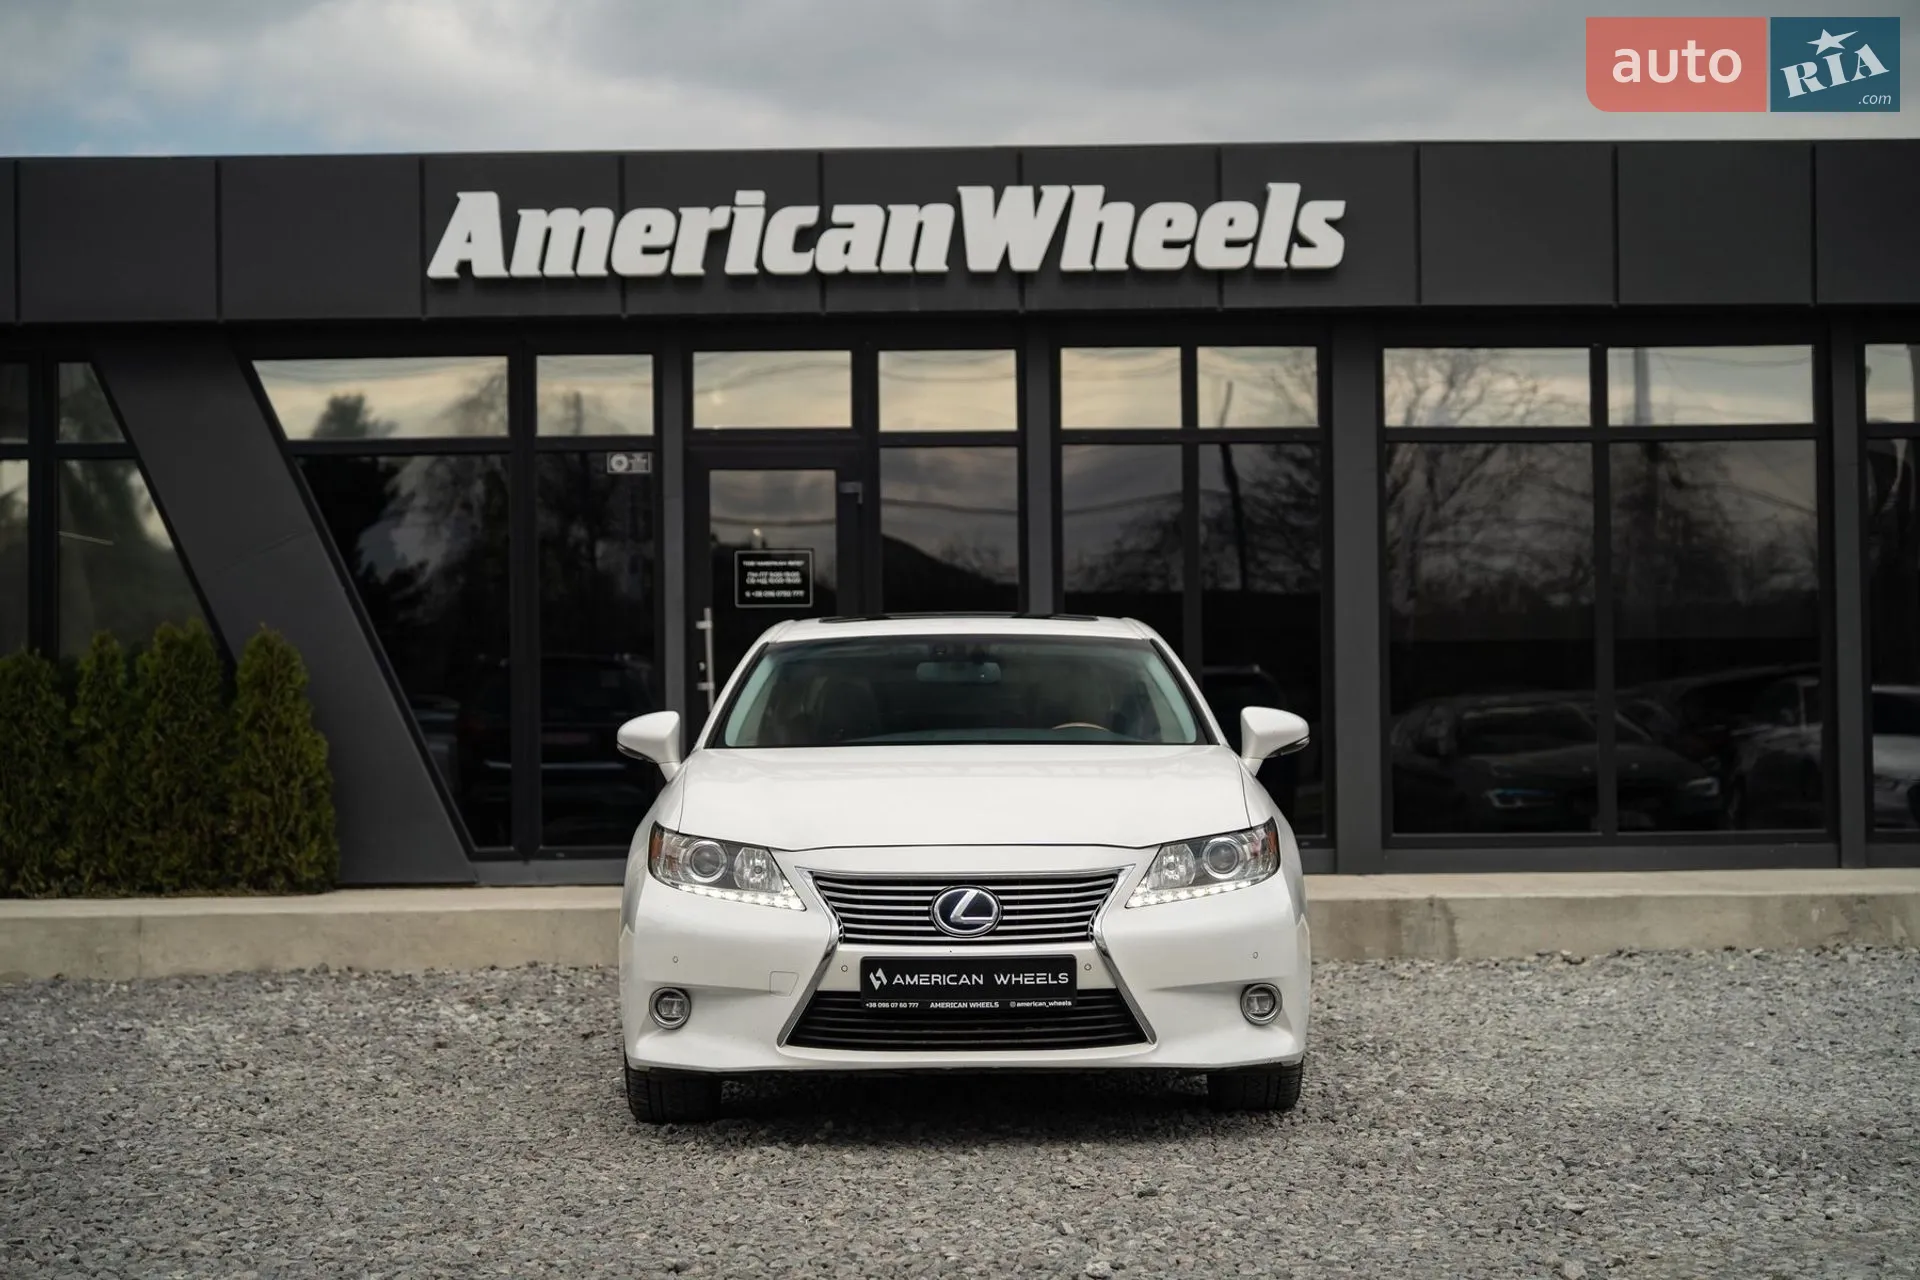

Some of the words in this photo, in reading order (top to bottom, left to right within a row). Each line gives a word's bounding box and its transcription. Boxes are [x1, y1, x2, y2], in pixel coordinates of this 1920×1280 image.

[427, 182, 1347, 280] AmericanWheels
[892, 973, 984, 986] AMERICAN
[994, 972, 1069, 985] WHEELS
[929, 1001, 968, 1009] AMERICAN
[969, 1001, 999, 1009] WHEELS
